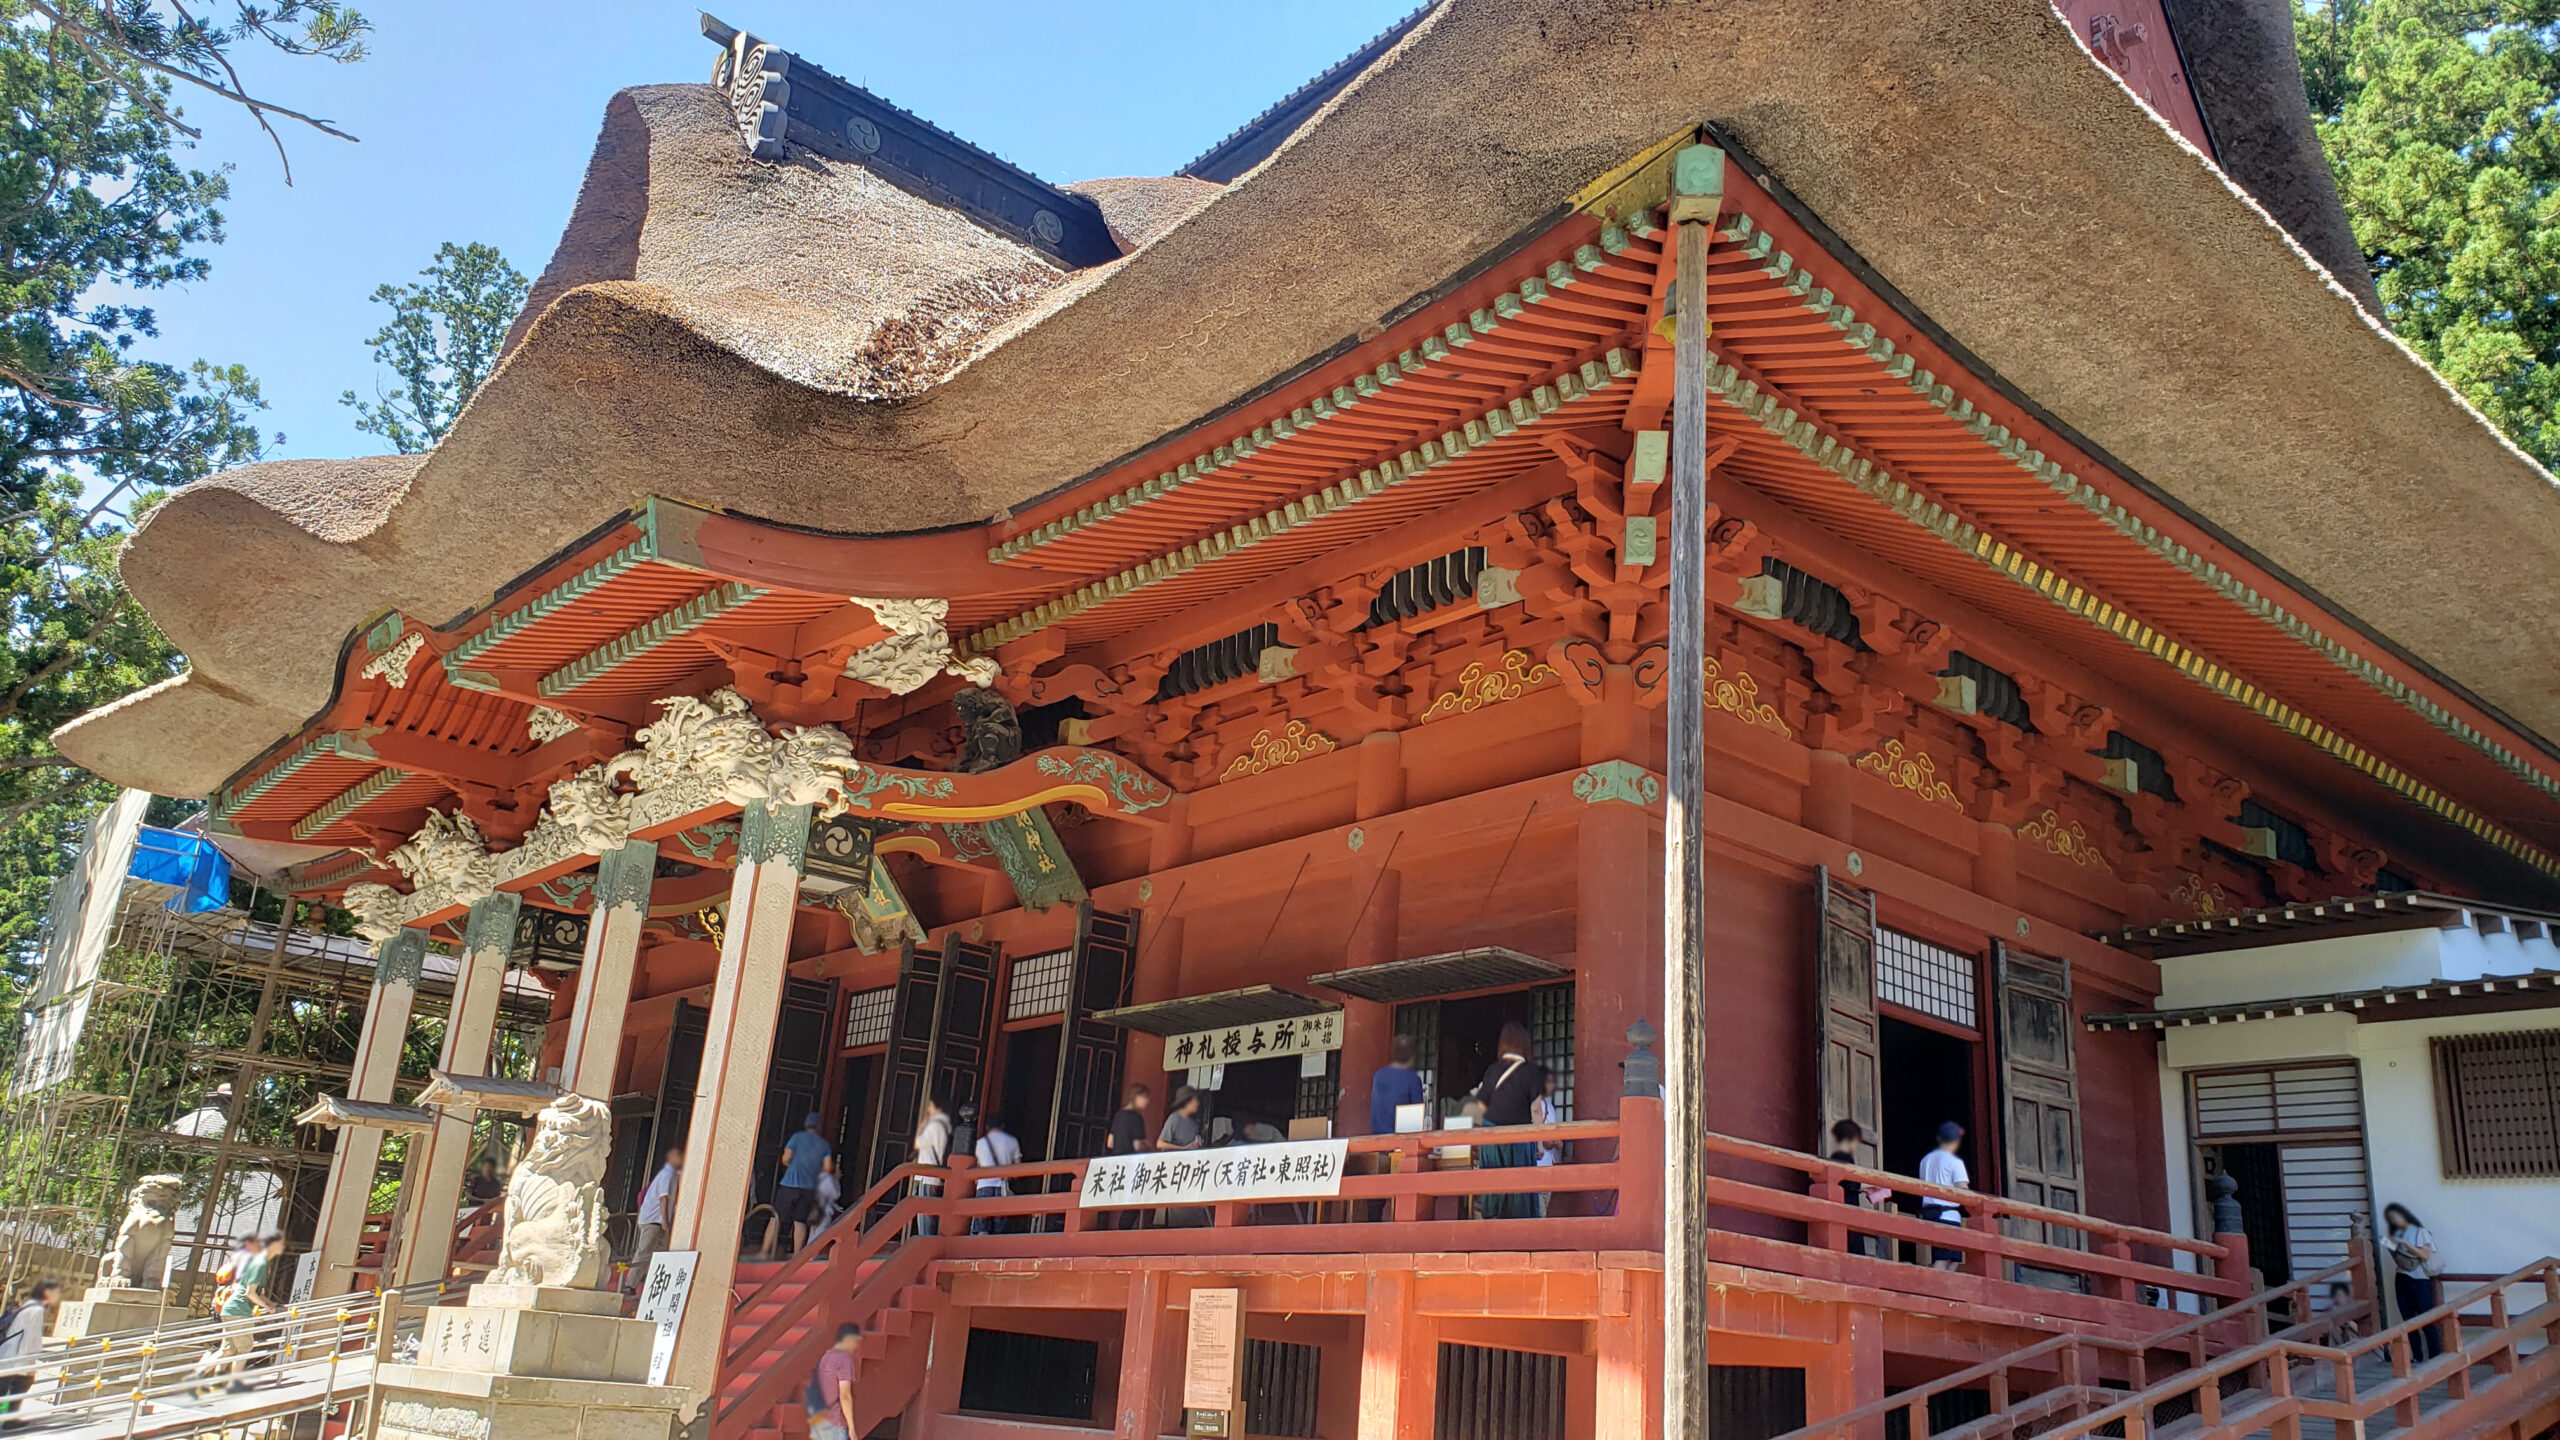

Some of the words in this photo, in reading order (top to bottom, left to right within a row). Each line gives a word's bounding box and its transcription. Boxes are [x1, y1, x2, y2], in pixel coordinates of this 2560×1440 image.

[1302, 1016, 1334, 1034] 御朱印
[1174, 1020, 1296, 1064] 神札授与所
